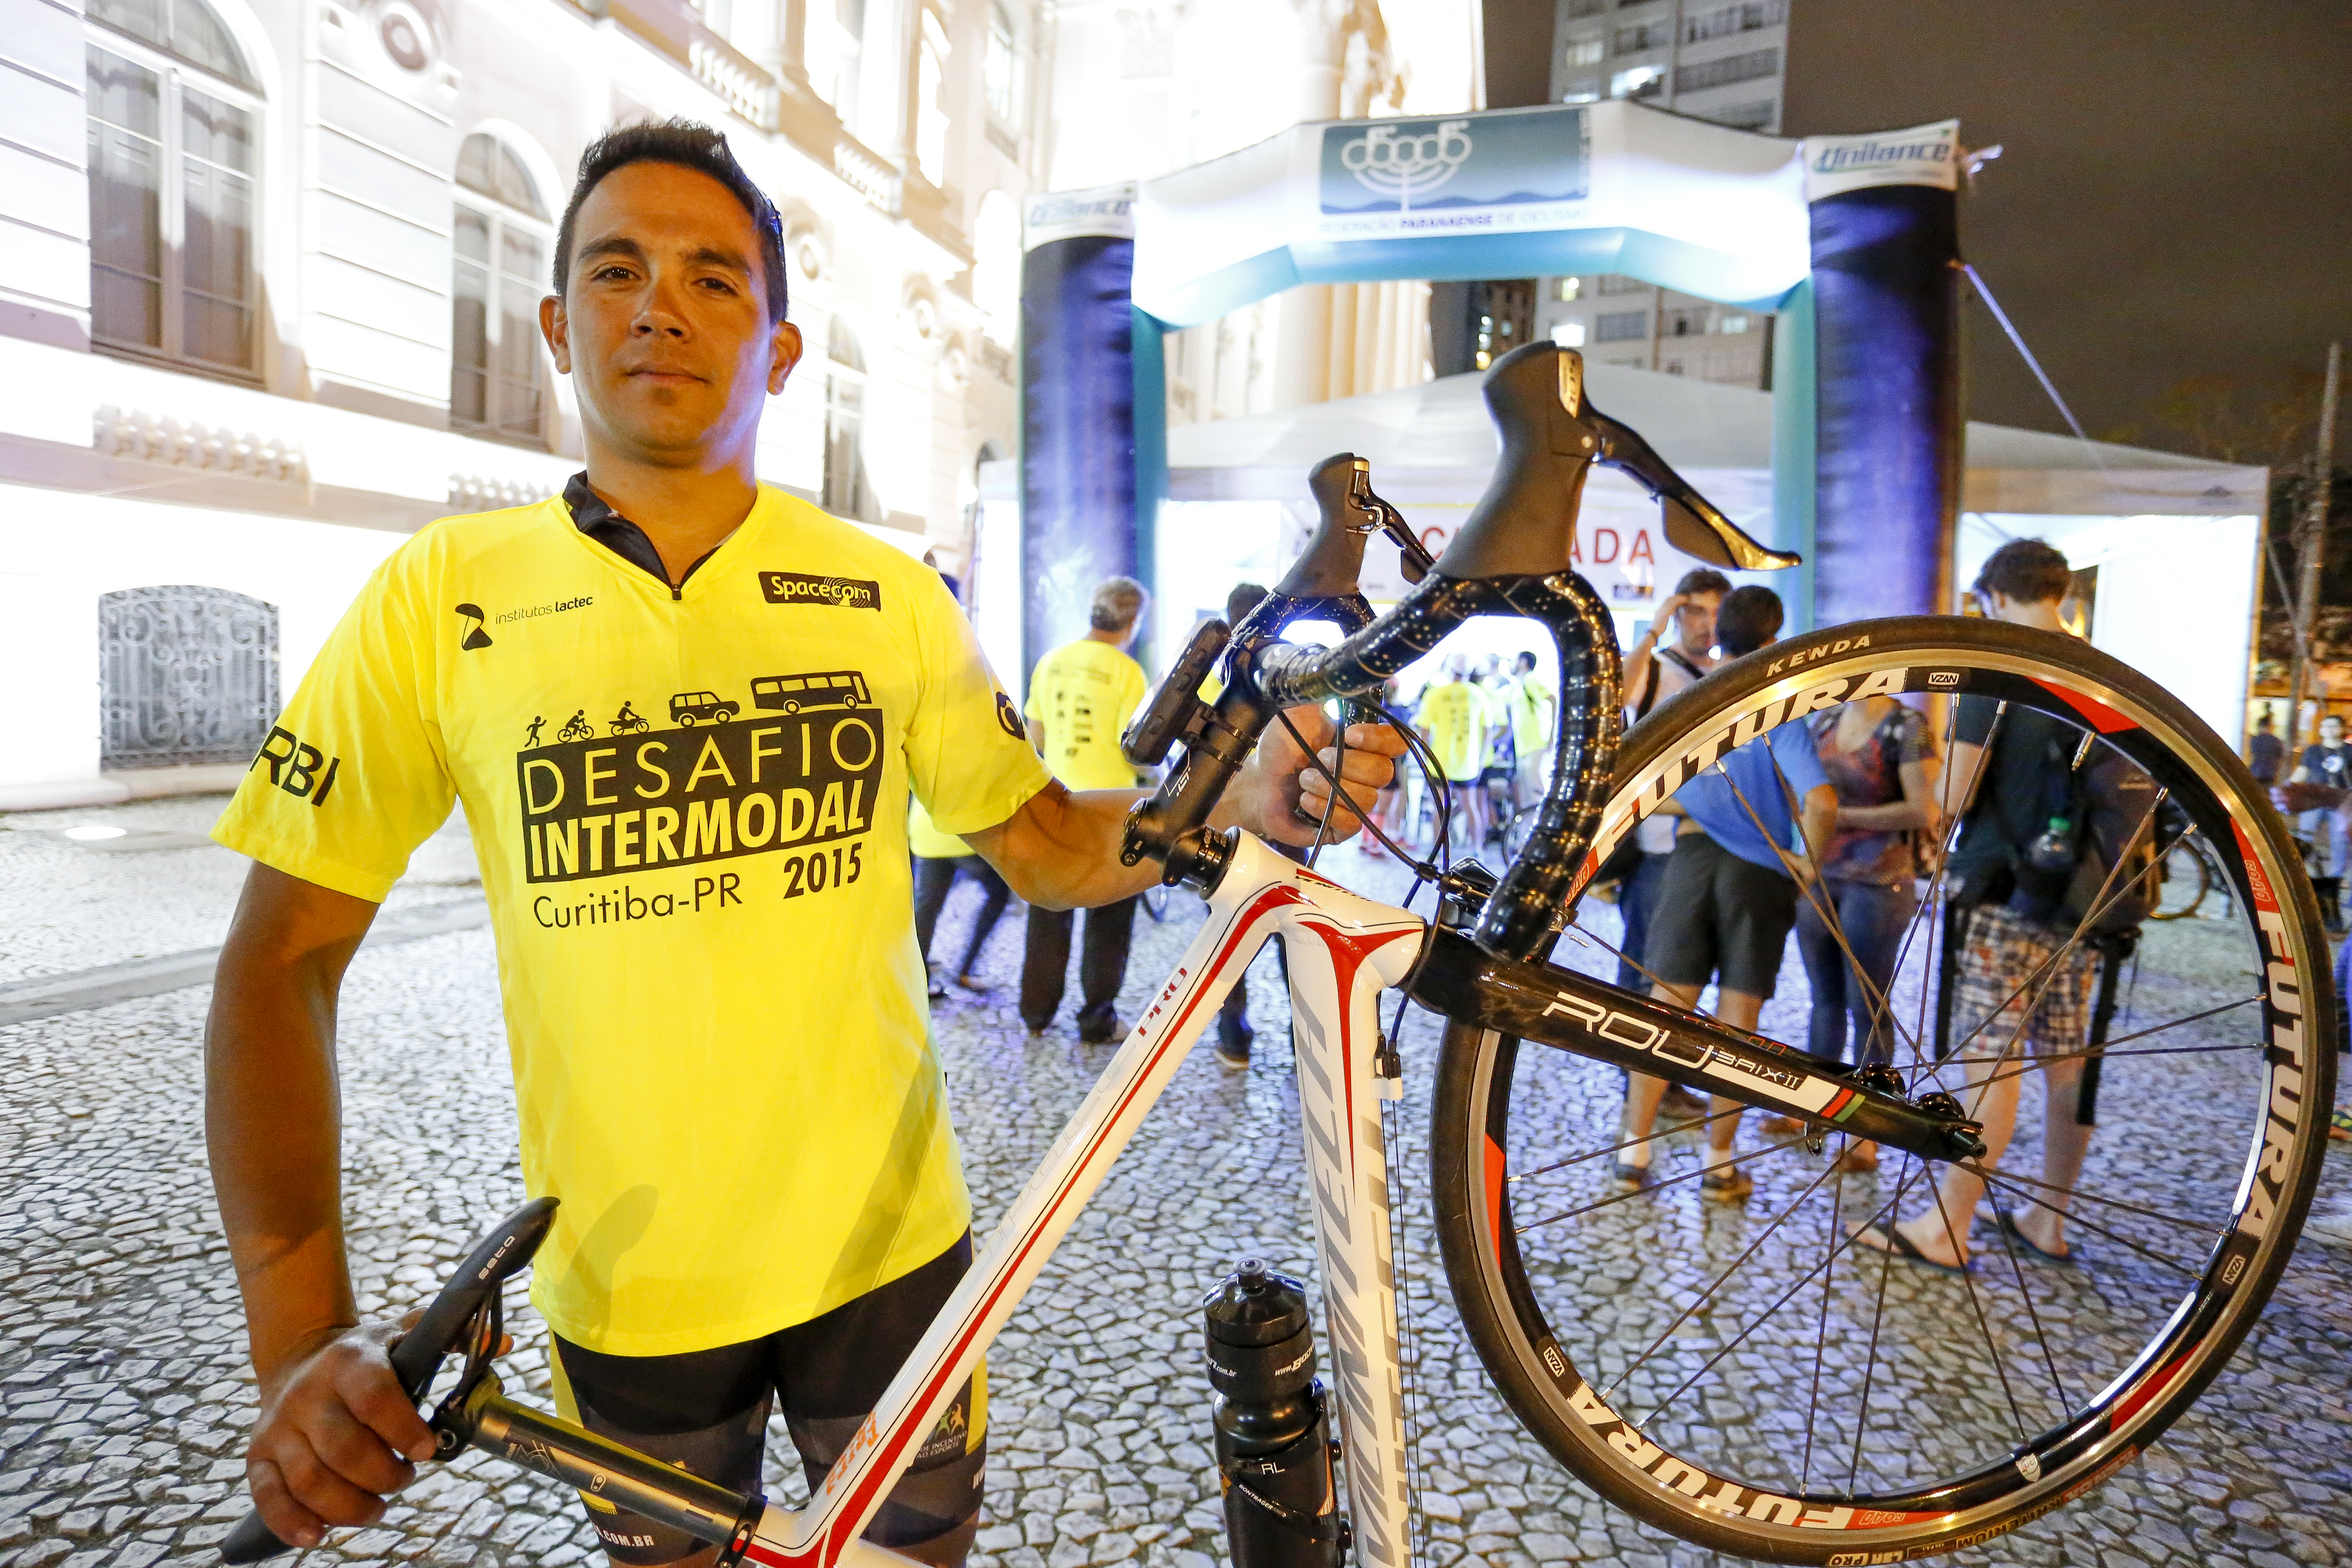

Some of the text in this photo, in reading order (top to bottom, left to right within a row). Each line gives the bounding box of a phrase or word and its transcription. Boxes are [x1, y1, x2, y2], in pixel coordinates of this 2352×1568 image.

[770, 576, 871, 602] Spacecom
[495, 595, 593, 624] institutos lactec
[1766, 635, 1871, 677] KENDA
[1930, 674, 1958, 684] VZAN
[523, 718, 876, 815] DESAFIO
[1593, 667, 1908, 867] FUTURA
[529, 779, 864, 877] INTERMODAL
[534, 843, 862, 928] Curitiba-PR 2015
[2238, 910, 2303, 1240] FUTURA
[2223, 1257, 2244, 1283] VZAN
[1544, 1348, 1563, 1376] VZAN
[932, 1431, 968, 1450] INCENTIVO
[1261, 1462, 1285, 1475] RL
[1567, 1381, 1854, 1529] FUTURA
[1239, 1484, 1274, 1510] BONTRAGER
[1859, 1510, 1906, 1526] ROAD
[1832, 1556, 1864, 1565] PRO
